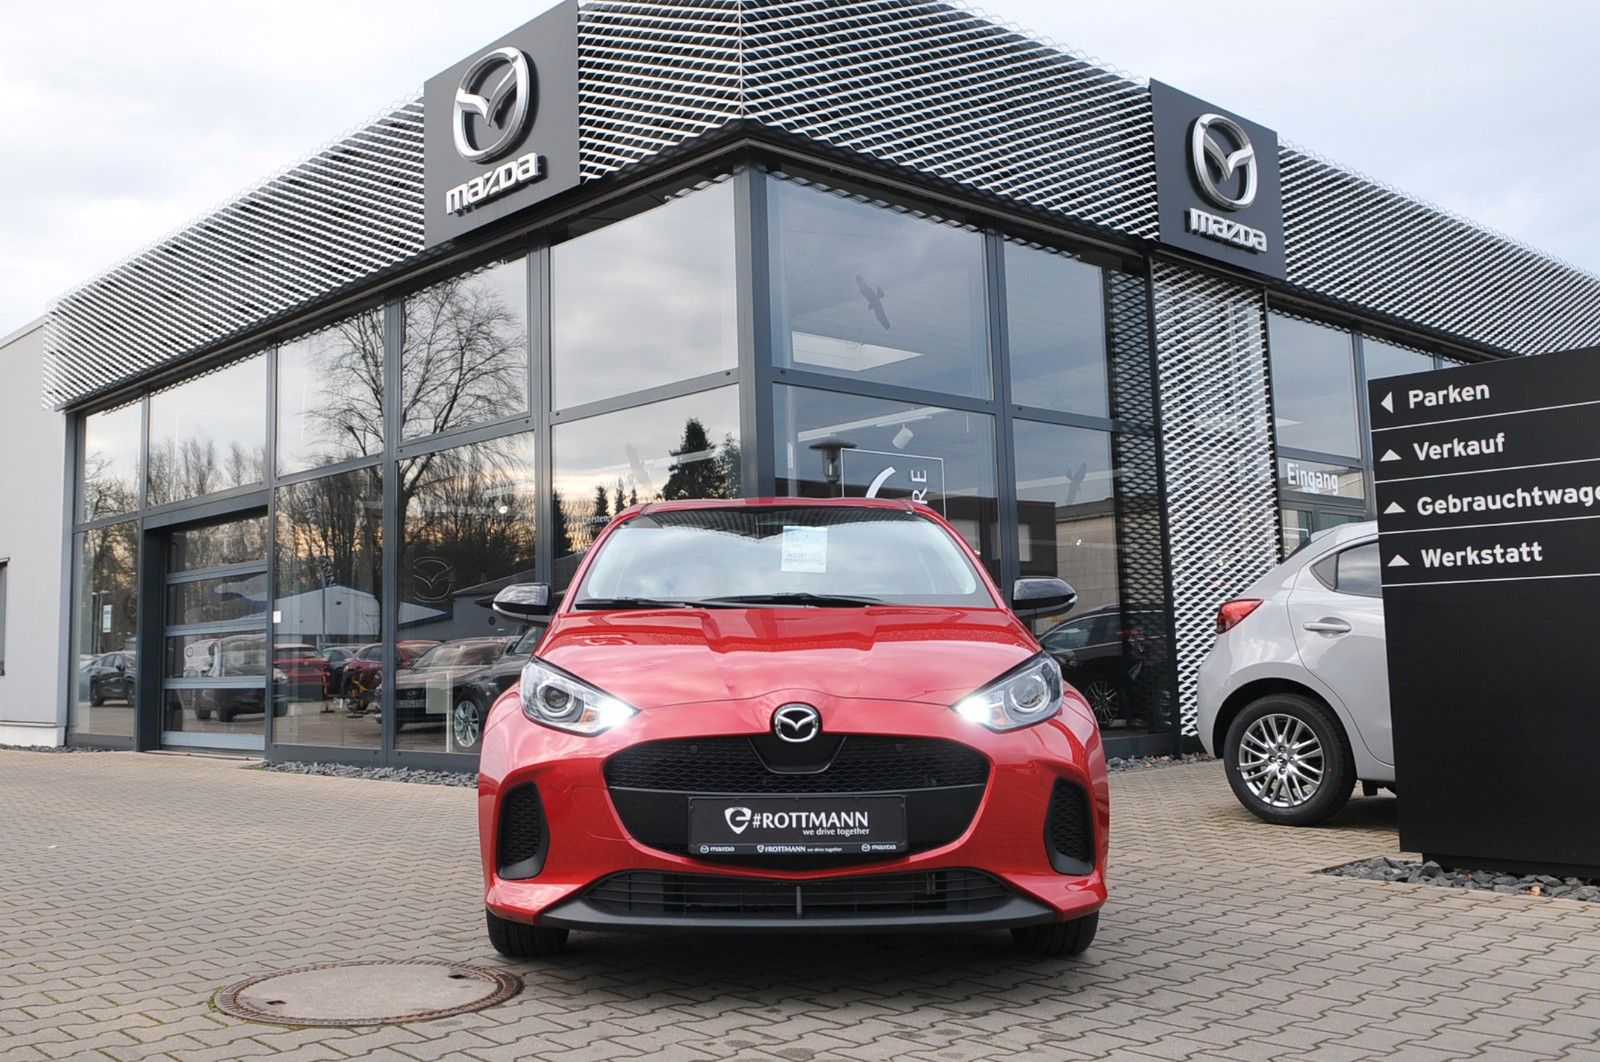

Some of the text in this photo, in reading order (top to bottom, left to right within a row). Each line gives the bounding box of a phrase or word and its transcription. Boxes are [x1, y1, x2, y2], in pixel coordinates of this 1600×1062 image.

[1408, 383, 1490, 409] Parken
[1413, 432, 1505, 461] Verkauf
[1287, 462, 1338, 496] Eingang
[1420, 541, 1543, 569] Werkstatt
[752, 811, 868, 829] #ROTTMANN
[816, 827, 835, 836] drive
[837, 827, 870, 838] together
